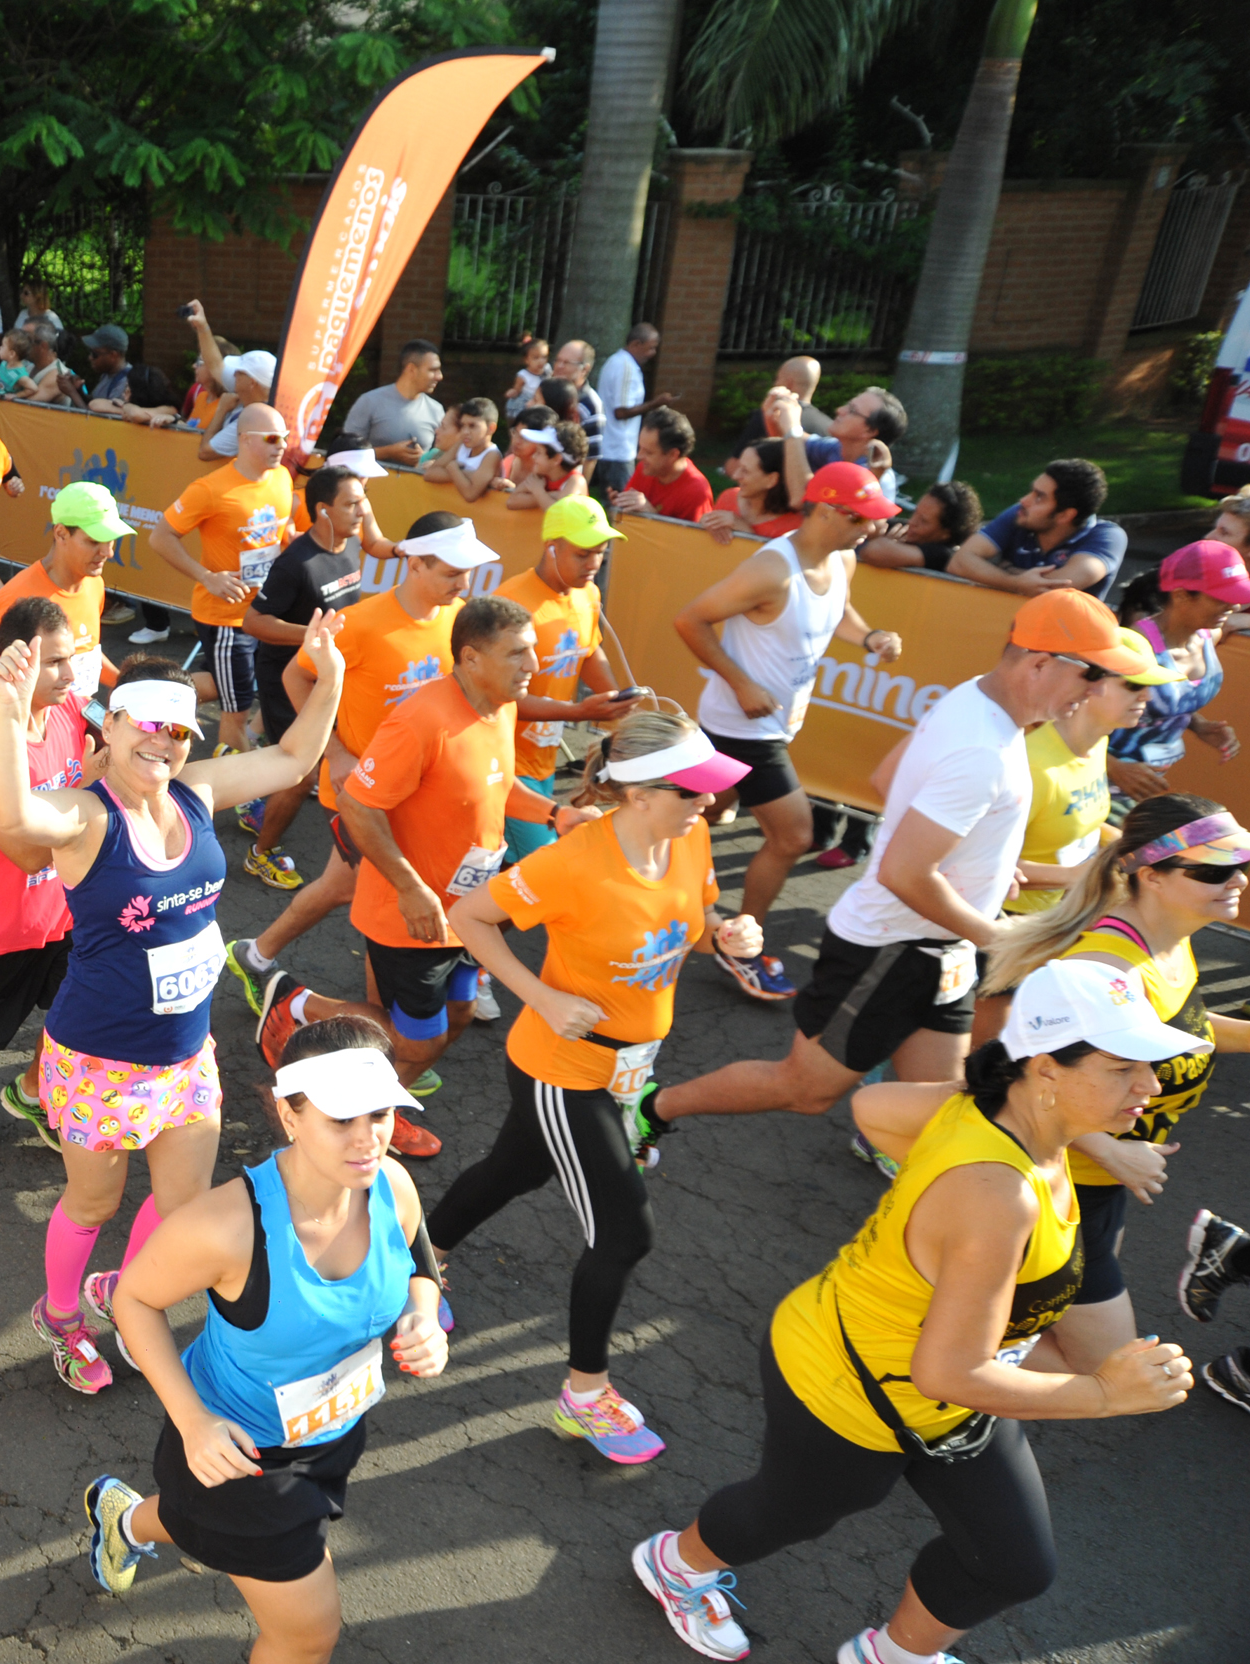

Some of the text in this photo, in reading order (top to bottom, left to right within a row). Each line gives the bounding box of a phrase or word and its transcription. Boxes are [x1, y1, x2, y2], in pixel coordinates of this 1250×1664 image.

[131, 505, 164, 523] MENO
[157, 886, 203, 912] sinta-se
[292, 1367, 371, 1438] 1157
